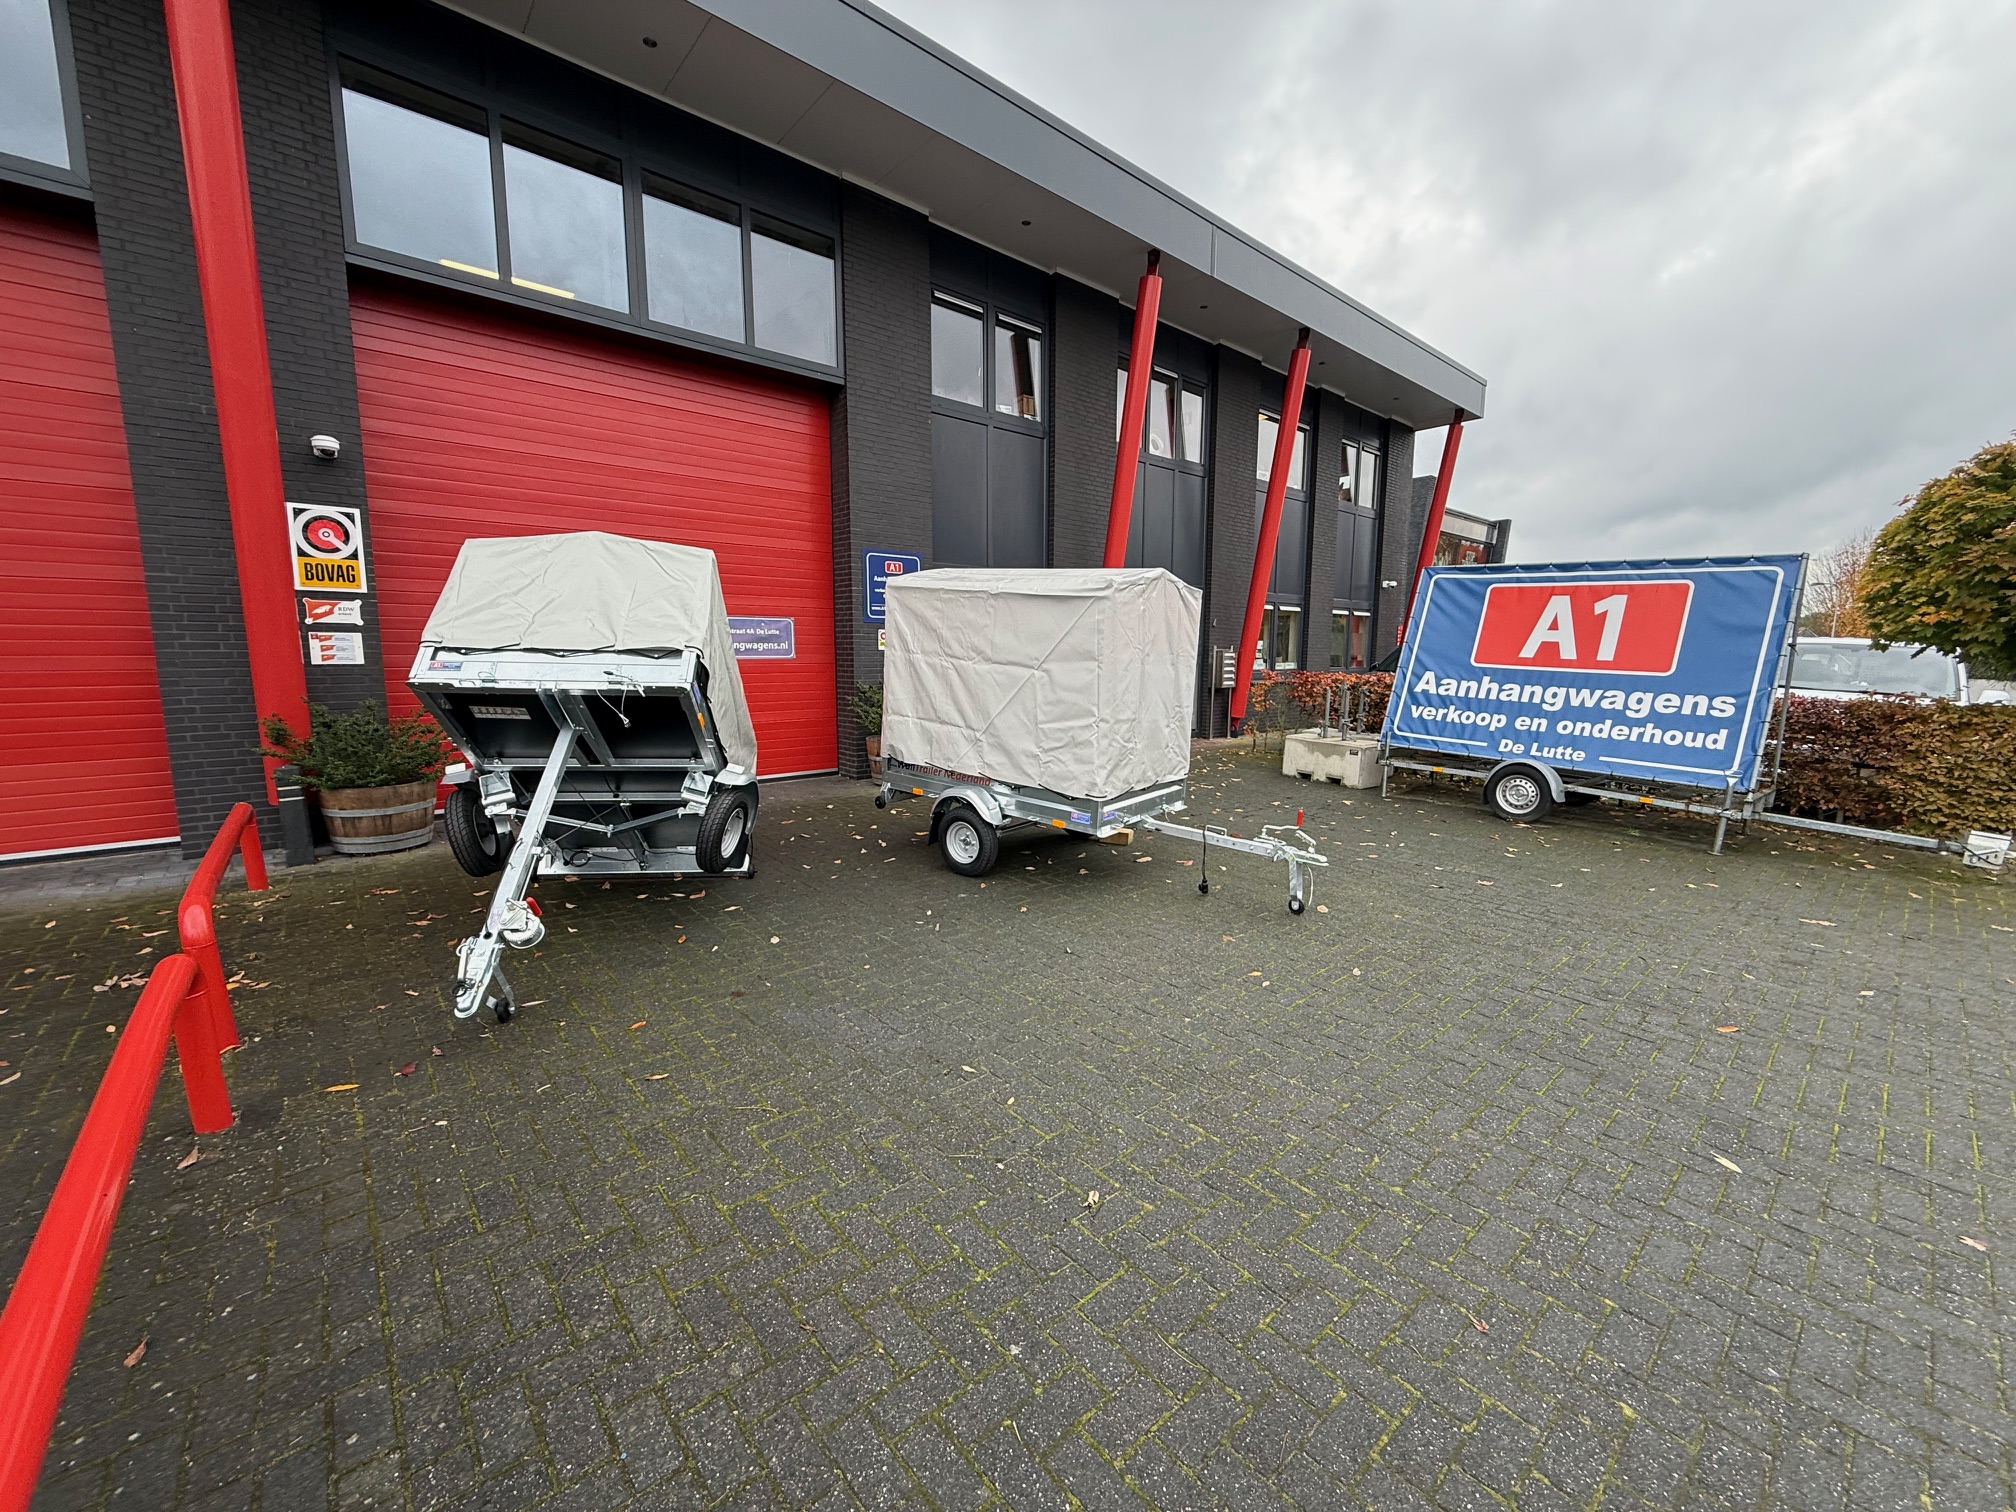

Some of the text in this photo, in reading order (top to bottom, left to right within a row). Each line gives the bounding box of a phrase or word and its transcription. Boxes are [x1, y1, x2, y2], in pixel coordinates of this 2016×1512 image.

[303, 562, 356, 583] BOVAG
[889, 563, 900, 572] A1
[1517, 594, 1629, 662] A1
[1413, 670, 1737, 719] Aanhangwagens
[1410, 702, 1729, 751] verkoop en onderhoud
[1498, 738, 1587, 762] De Lutte
